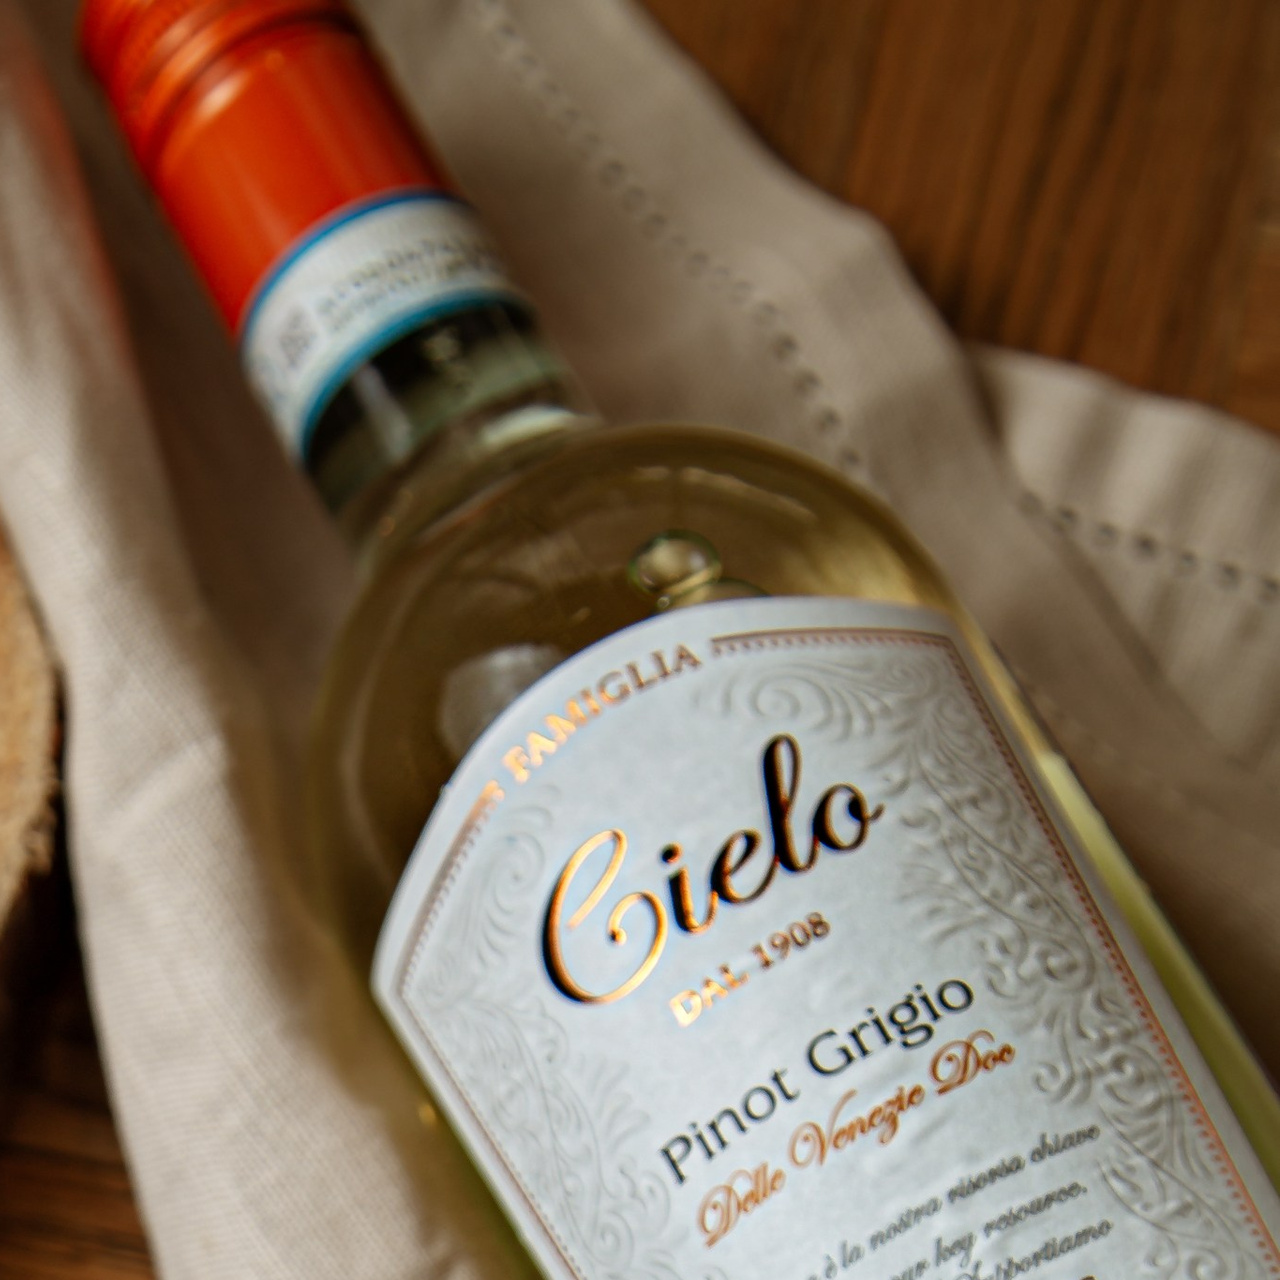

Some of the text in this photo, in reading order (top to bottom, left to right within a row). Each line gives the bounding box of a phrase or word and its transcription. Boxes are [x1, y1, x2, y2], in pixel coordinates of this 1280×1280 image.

[502, 642, 704, 784] FAMIGLIA
[542, 733, 887, 1006] Cielo
[669, 911, 833, 1029] DAL 1908
[660, 978, 975, 1187] Pinot Grigio
[697, 1029, 1016, 1249] Delle Venezie Doc
[824, 1253, 838, 1280] è
[841, 1239, 865, 1269] la
[870, 1197, 943, 1251] nostra
[947, 1154, 1026, 1204] risorsa
[1030, 1123, 1101, 1163] chiave
[934, 1230, 976, 1269] key
[983, 1181, 1087, 1238] resource.
